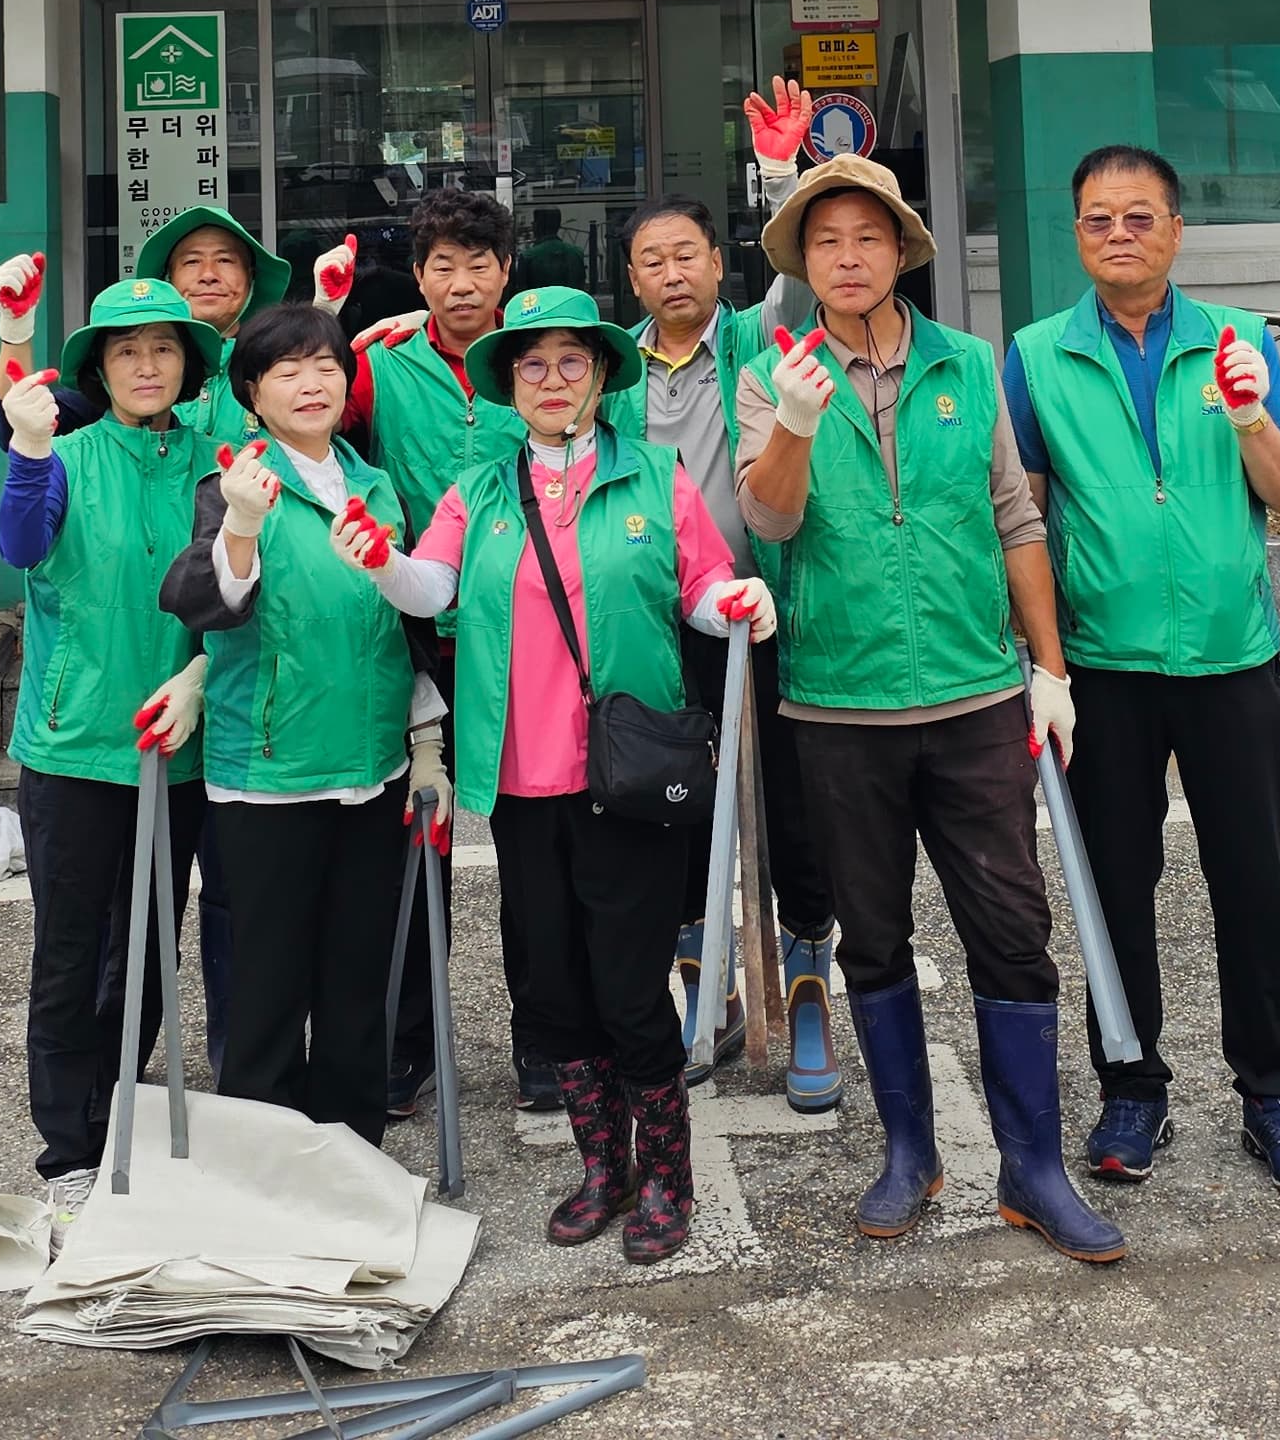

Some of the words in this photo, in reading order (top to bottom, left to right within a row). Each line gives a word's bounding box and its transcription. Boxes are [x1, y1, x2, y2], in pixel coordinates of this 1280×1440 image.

[471, 5, 501, 20] ADT
[818, 39, 860, 53] 대피소
[126, 114, 217, 139] 무더위
[936, 416, 963, 427] SMU
[625, 535, 652, 545] SMU
